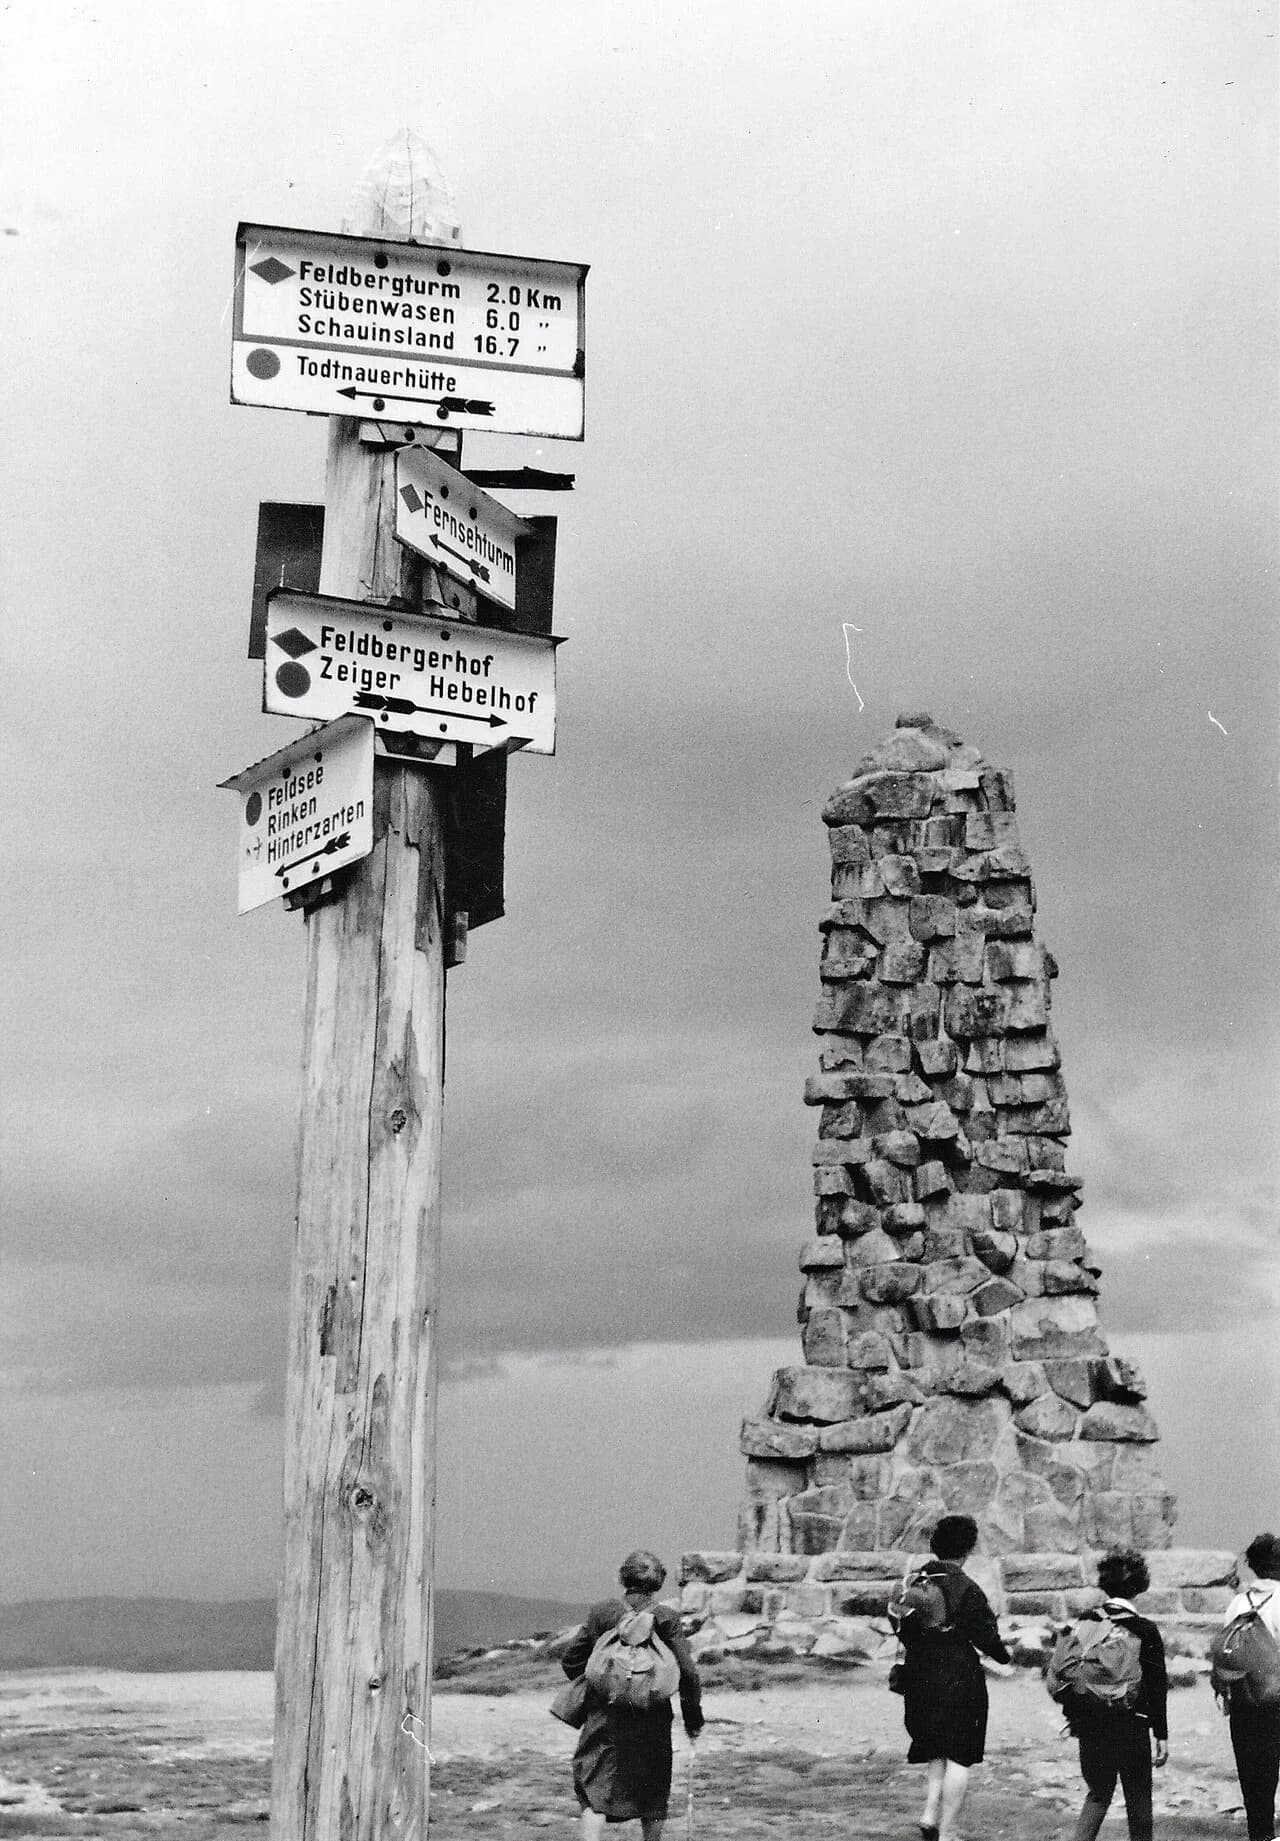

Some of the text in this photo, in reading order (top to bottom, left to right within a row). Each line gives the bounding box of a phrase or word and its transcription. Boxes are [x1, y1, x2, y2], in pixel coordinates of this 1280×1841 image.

[299, 287, 455, 324] Stübenwasen
[486, 310, 520, 332] 6.0
[300, 261, 562, 311] Feldbergturm 2.0 Km
[298, 314, 454, 350] Schauinsland
[473, 334, 520, 357] 16.7
[297, 355, 457, 392] Todtnauerhütte
[424, 490, 514, 576] Fernsehturm
[320, 626, 494, 677] Feldbergerhof
[320, 656, 538, 713] Zeiger Hebelhof
[268, 766, 324, 810] Feldsee
[267, 800, 364, 864] Hinterzarten
[268, 797, 317, 836] Rinken
